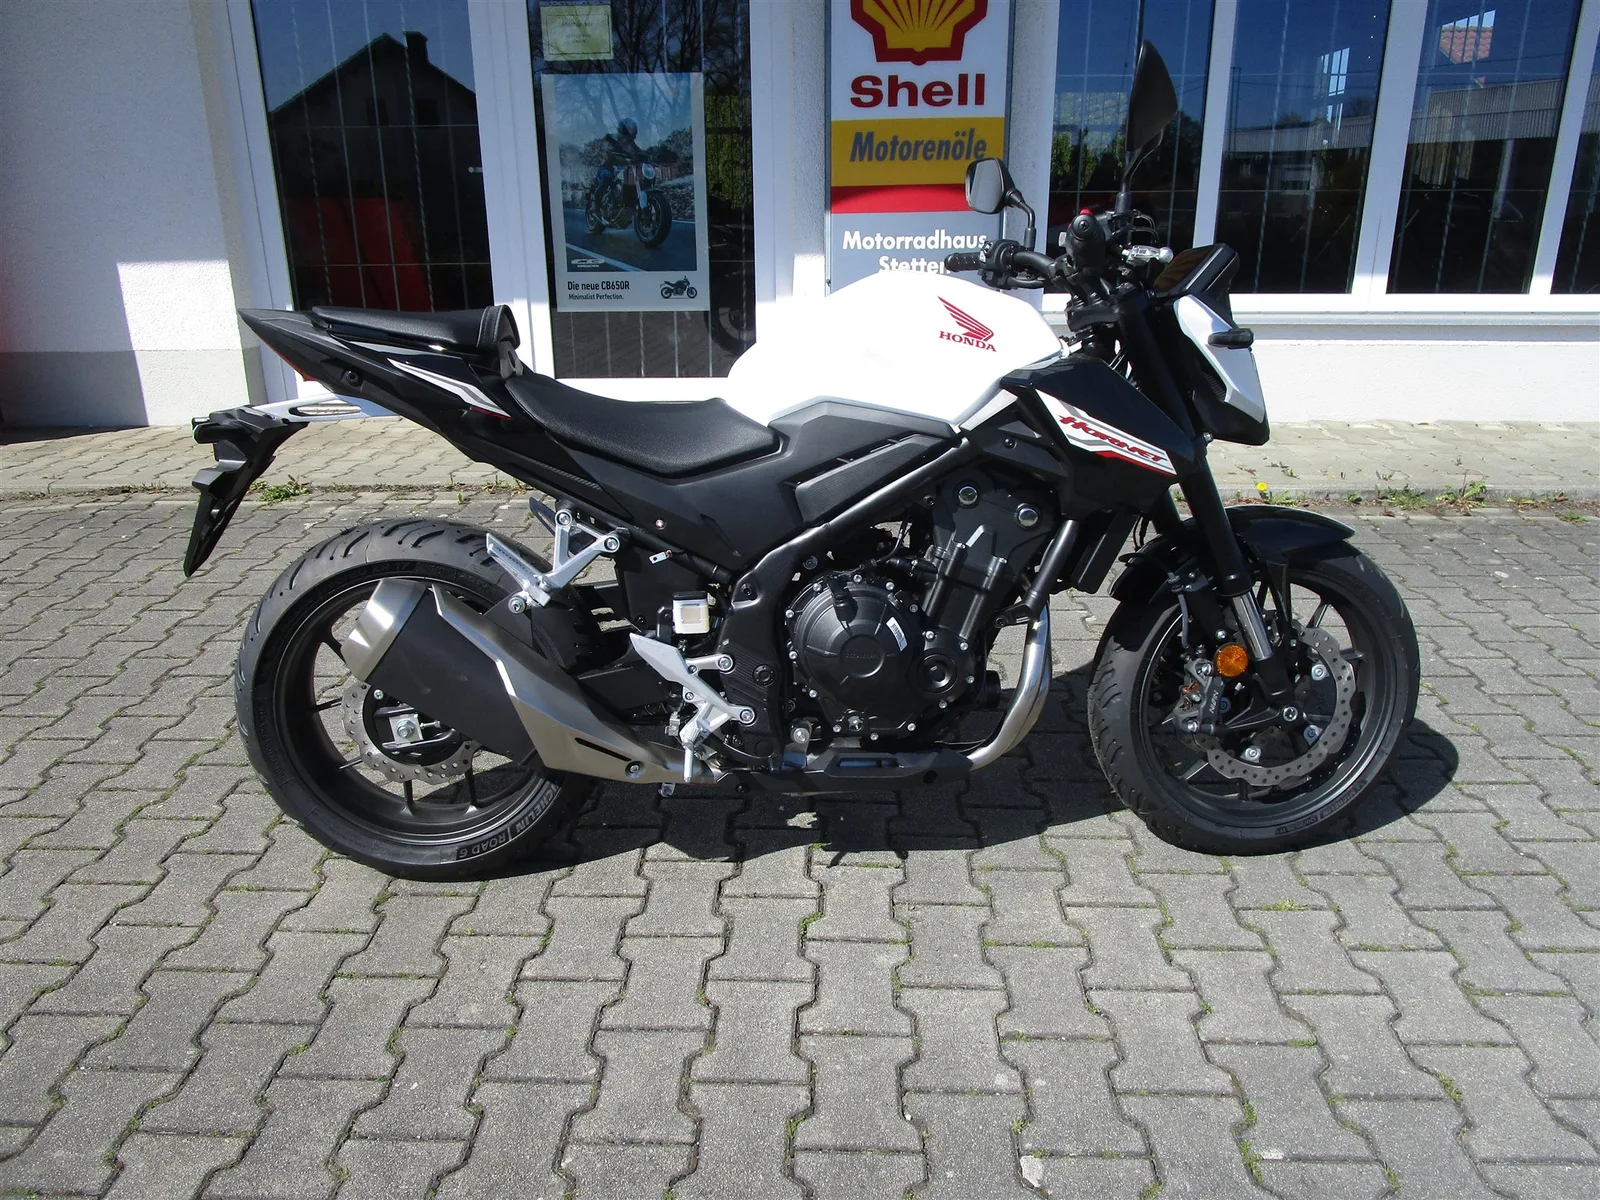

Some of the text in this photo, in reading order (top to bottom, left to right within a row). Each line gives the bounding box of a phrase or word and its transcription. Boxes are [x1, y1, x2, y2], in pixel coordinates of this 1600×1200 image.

[850, 73, 986, 108] Shell
[850, 128, 987, 162] Motorenöle
[842, 229, 988, 250] Motorradhaus
[567, 281, 580, 290] Die
[601, 280, 630, 290] CB650R
[939, 330, 997, 352] HONDA
[515, 782, 561, 833] ICHELIN
[459, 832, 507, 858] ROAD 6
